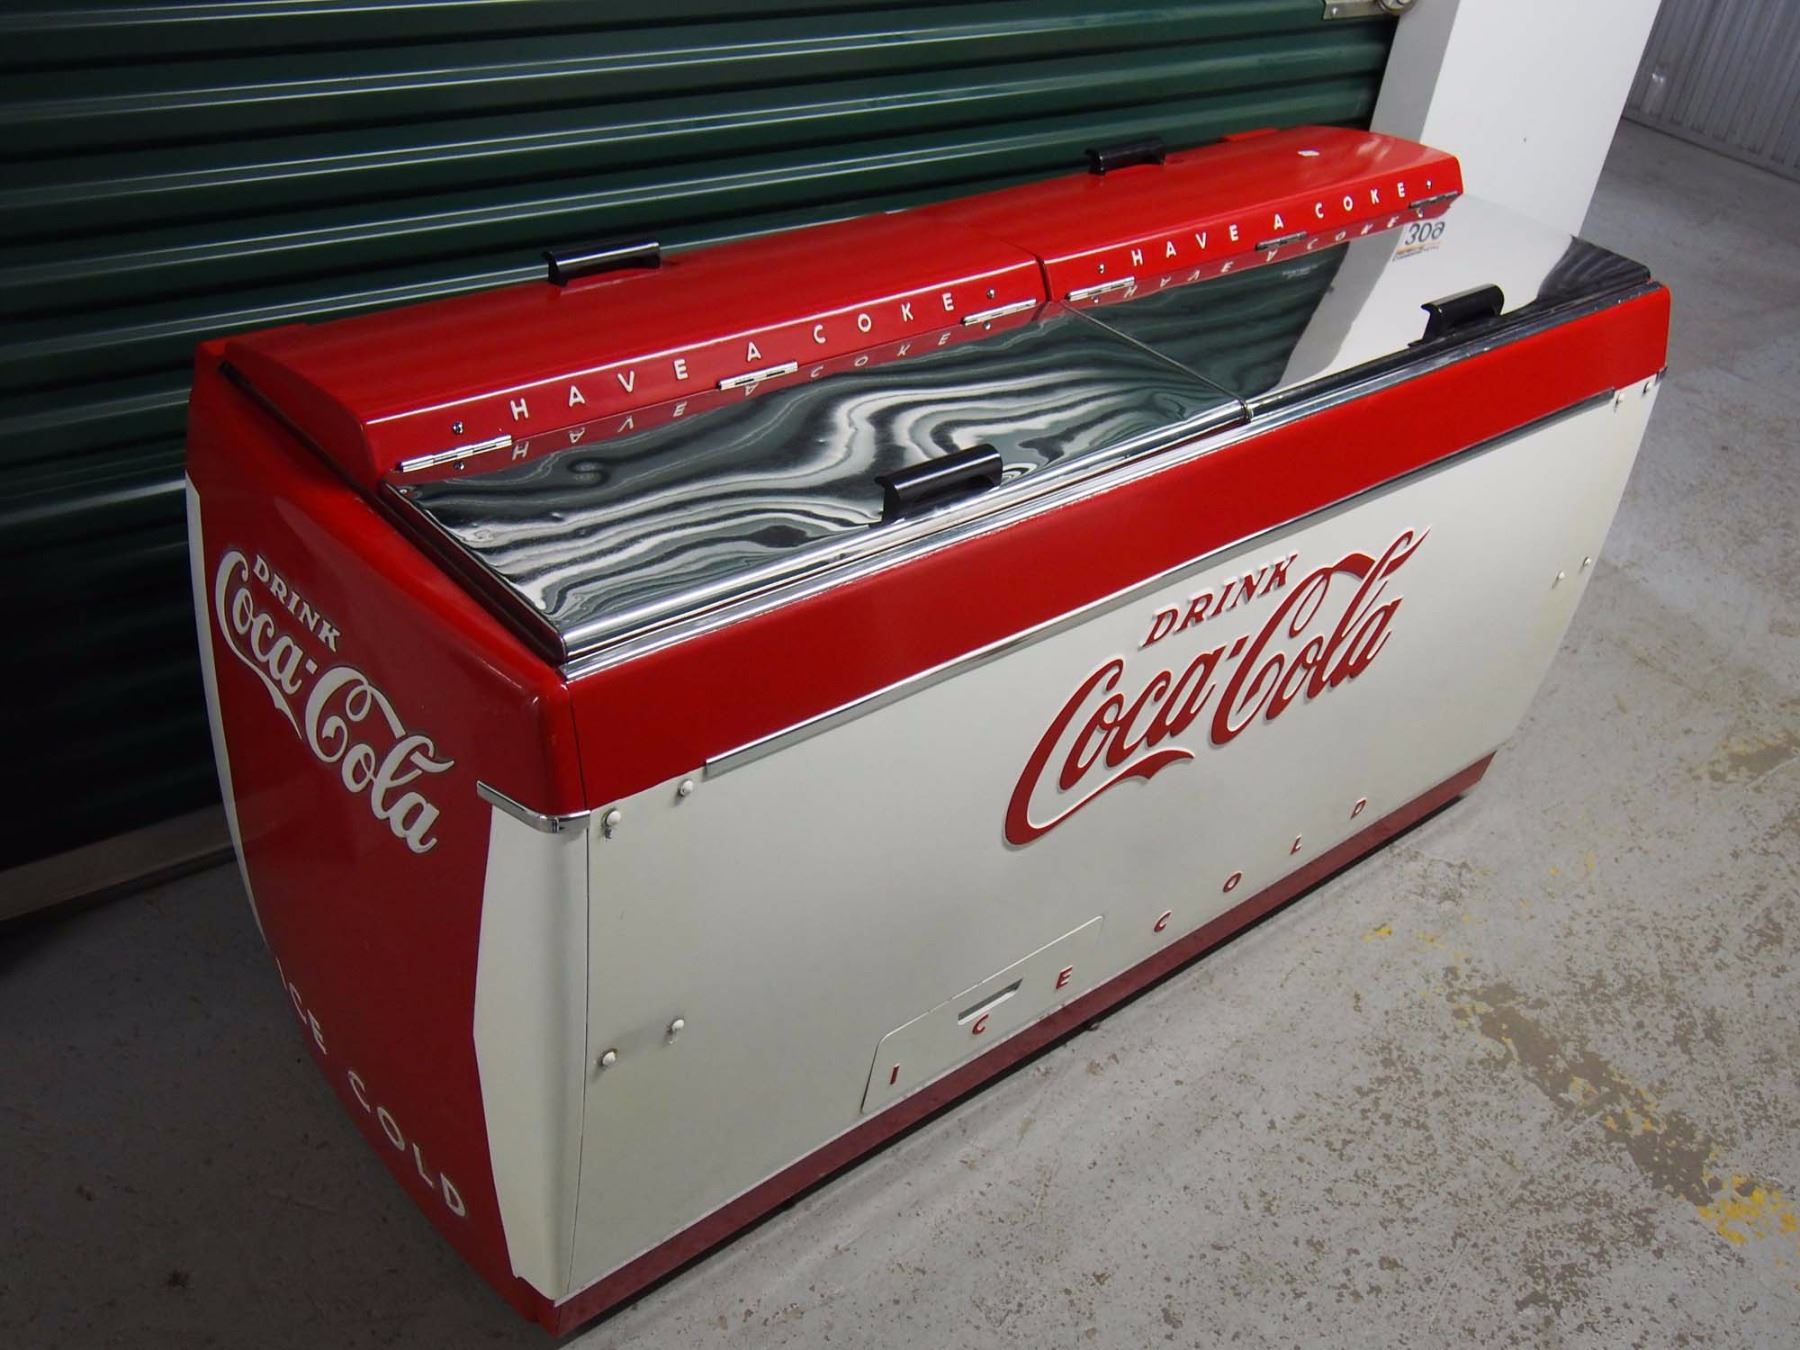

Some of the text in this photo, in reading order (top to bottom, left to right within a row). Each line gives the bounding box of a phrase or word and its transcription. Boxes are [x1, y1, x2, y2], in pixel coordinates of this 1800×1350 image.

[1131, 181, 1406, 266] HAVE A COKE
[509, 292, 954, 421] HAVE A COKE
[252, 553, 342, 653] DRINK
[1139, 553, 1299, 648] DRINK
[215, 551, 455, 854] Coca-Cola
[1004, 526, 1432, 846] Coca-Cola
[889, 796, 1367, 1086] ICE COLD
[348, 1068, 467, 1217] COLD
